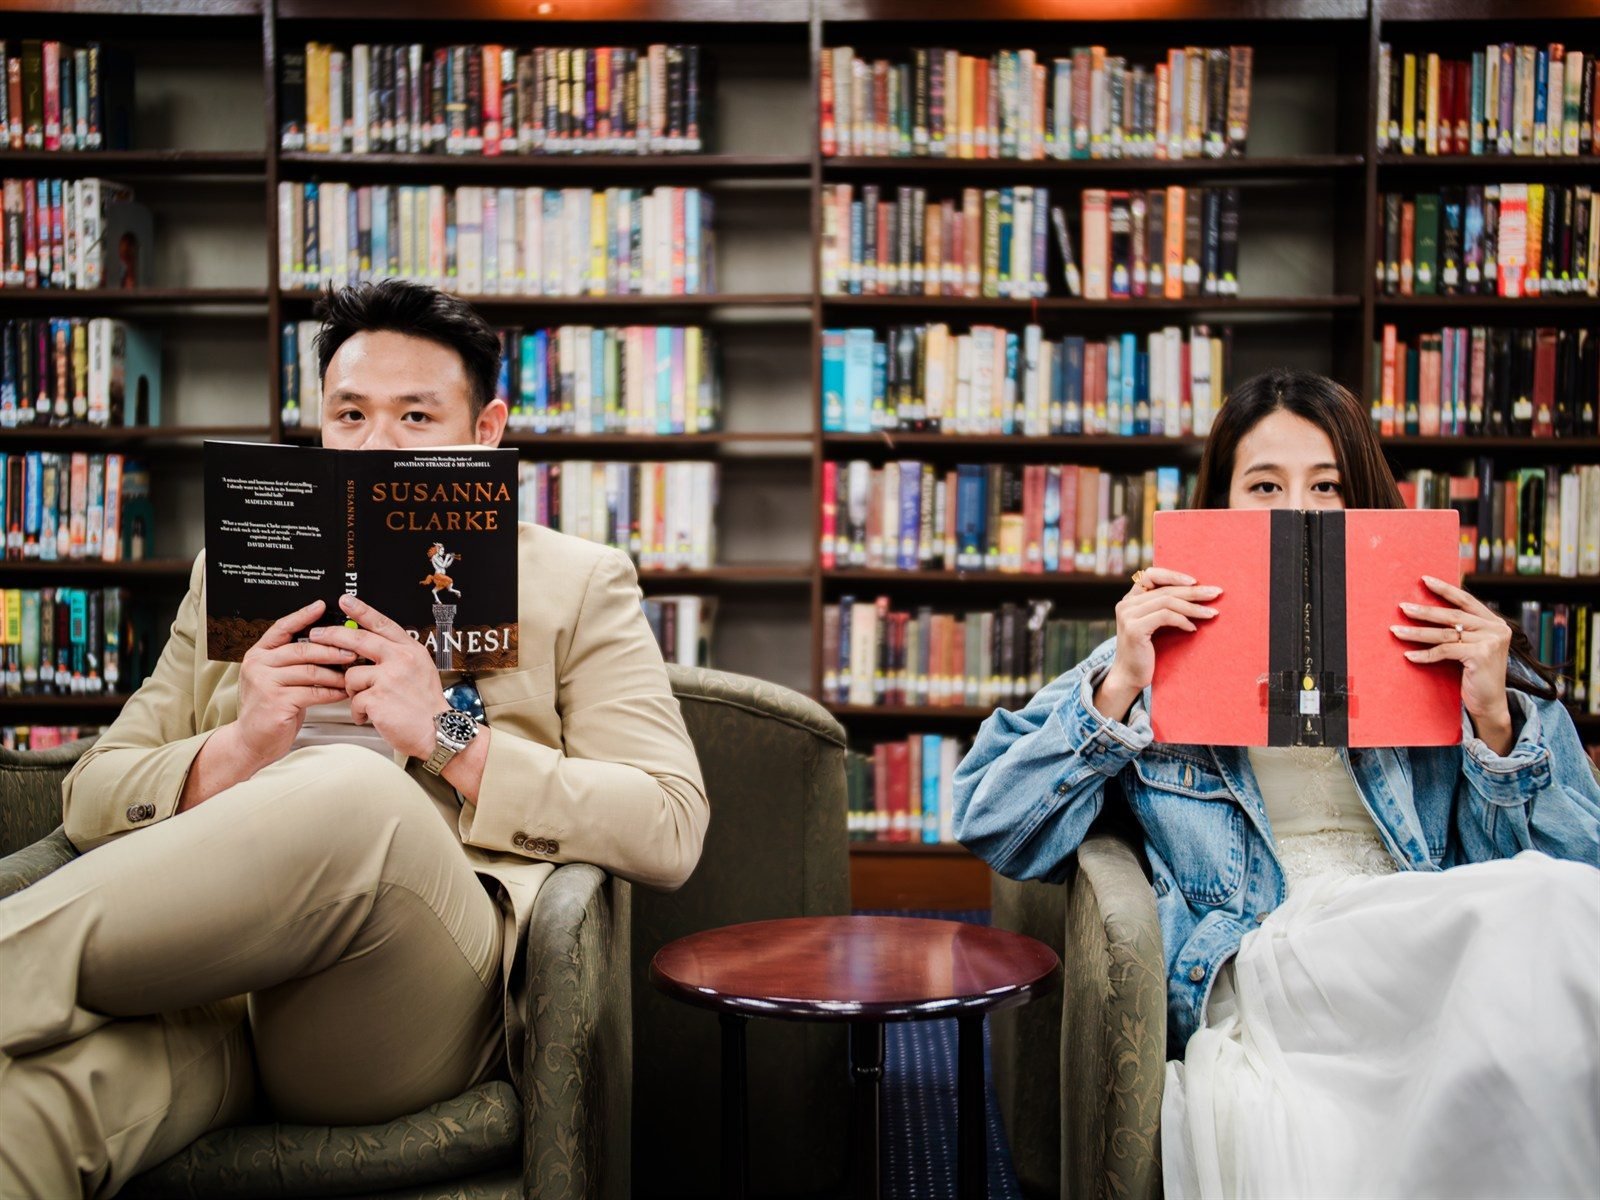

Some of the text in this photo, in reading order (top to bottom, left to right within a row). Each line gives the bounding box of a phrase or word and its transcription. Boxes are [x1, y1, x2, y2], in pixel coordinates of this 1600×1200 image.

[372, 482, 511, 502] SUSANNA
[347, 480, 355, 527] SUSANNA
[386, 510, 498, 531] CLARKE
[347, 530, 355, 569] CLARKE
[258, 579, 299, 587] MORGENSTERN
